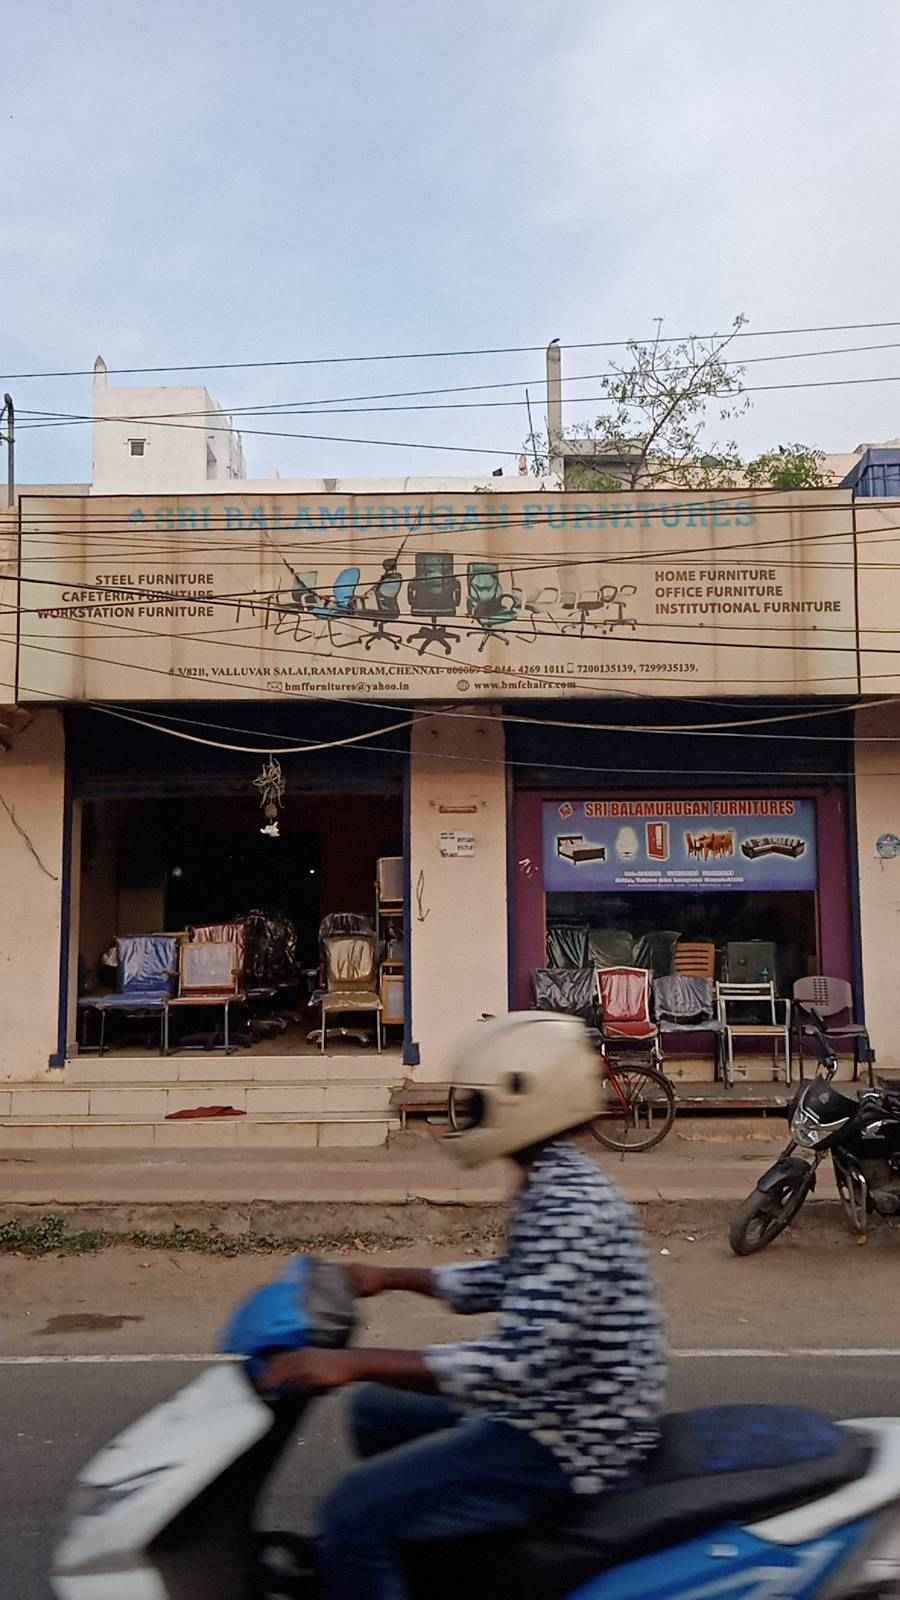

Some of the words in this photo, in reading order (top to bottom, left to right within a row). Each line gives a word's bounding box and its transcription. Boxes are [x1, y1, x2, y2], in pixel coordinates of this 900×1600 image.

[522, 501, 756, 532] FURNITURES
[95, 575, 135, 585] STEEL
[138, 573, 214, 585] FURNITURE
[655, 570, 696, 582] HOME
[699, 569, 776, 581] FURNITURE
[61, 590, 134, 602] CAFETERIA
[655, 586, 703, 598] OFFICE
[706, 585, 783, 597] FURNITURE
[37, 607, 134, 619] WORKSTATION
[138, 606, 214, 617] FURNITURE
[655, 602, 761, 614] INSTITUTIONAL
[764, 600, 841, 613] FURNITURE
[211, 667, 271, 676] VALLUVAR
[518, 665, 541, 674] 4269
[544, 665, 565, 674] 1011
[577, 664, 637, 674] 7200135139,
[640, 663, 699, 673] 7299935139.
[285, 682, 409, 692] bmffurnitures@yahoo.in
[474, 680, 577, 689] www.bmfchairs.com
[584, 801, 608, 817] SRI
[611, 801, 710, 817] BALAMURUGAN
[713, 800, 795, 816] FURNITURES
